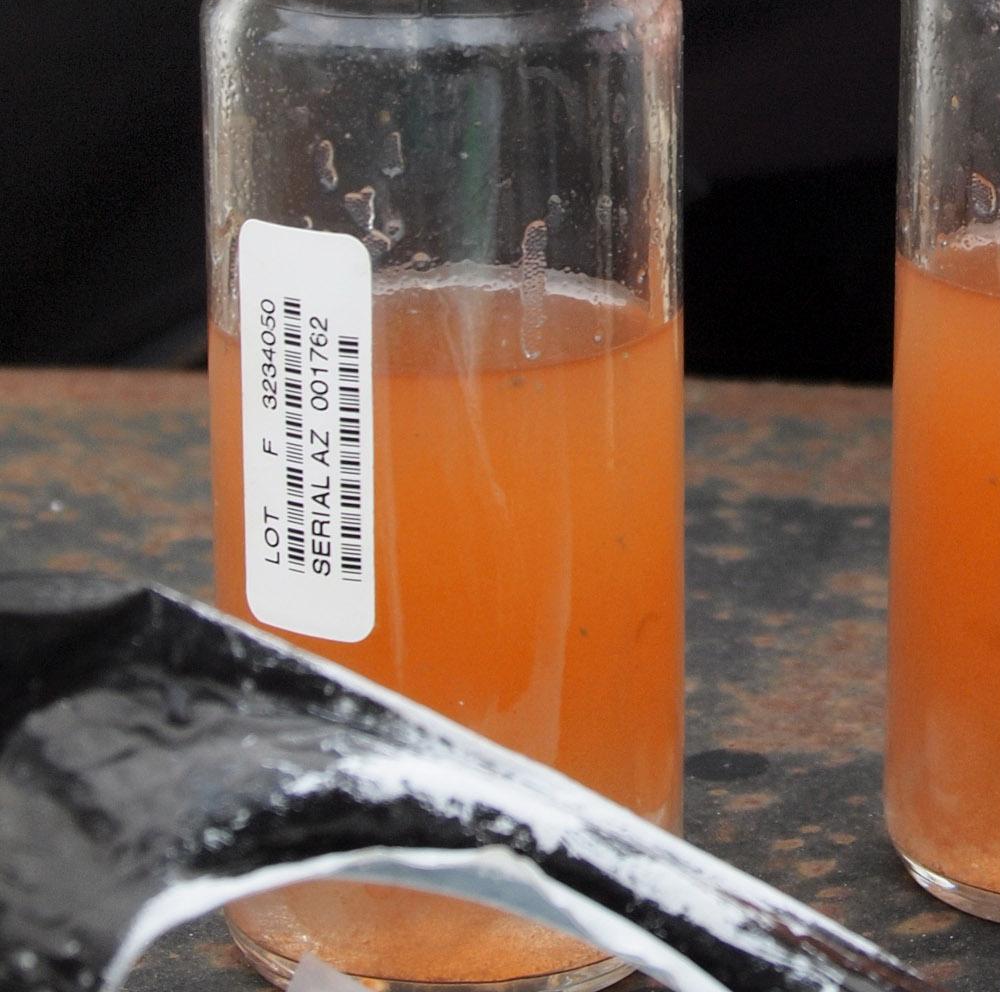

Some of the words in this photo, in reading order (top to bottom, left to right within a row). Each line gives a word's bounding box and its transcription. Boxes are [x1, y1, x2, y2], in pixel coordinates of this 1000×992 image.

[260, 298, 277, 410] 3234050
[309, 316, 329, 412] 001762
[263, 438, 279, 456] F
[310, 429, 330, 467] AZ
[264, 506, 280, 565] LOT
[311, 475, 331, 577] SERIAL
